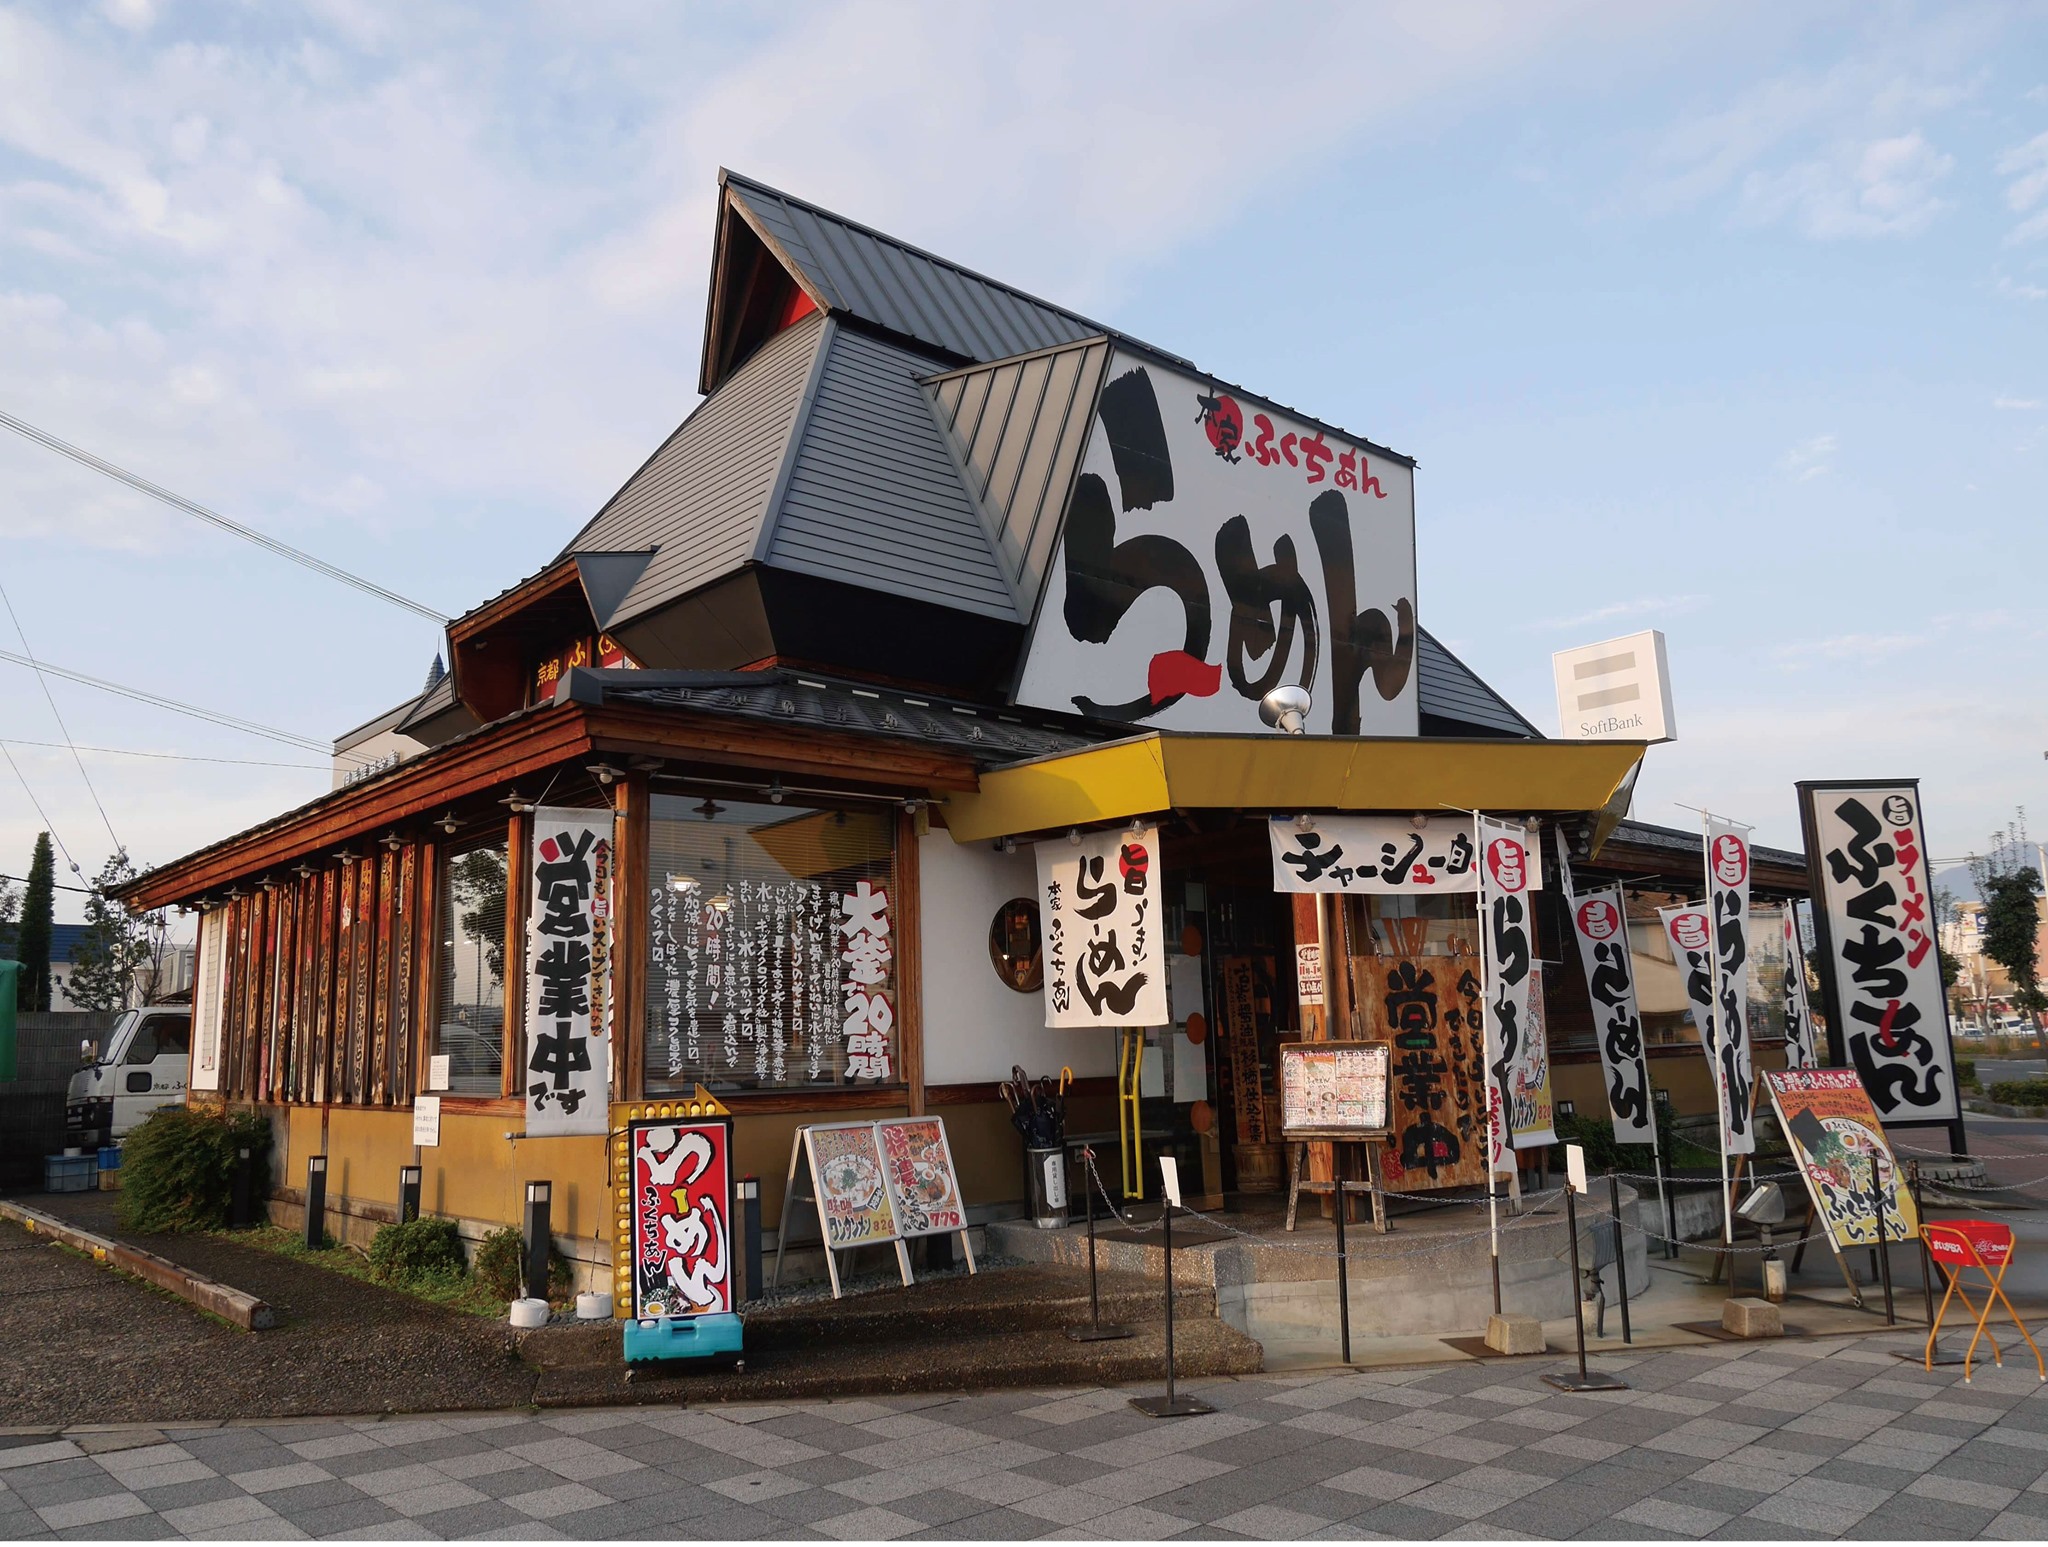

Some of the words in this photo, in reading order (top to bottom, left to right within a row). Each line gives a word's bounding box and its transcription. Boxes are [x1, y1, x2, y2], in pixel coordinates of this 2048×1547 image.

[1194, 387, 1242, 465] 本家
[1244, 413, 1388, 498] ふくちあん
[1063, 366, 1414, 735] らーめん
[537, 658, 560, 687] 京都
[1580, 713, 1643, 737] SoftBank
[529, 828, 596, 1115] 営業中です
[1047, 880, 1063, 912] 本家
[1048, 917, 1071, 1014] ふくちあん
[1073, 855, 1149, 1017] らーめん
[1826, 797, 1945, 1114] ふくちあん
[1893, 828, 1933, 969] ラーメン
[840, 881, 893, 1078] 大釜で20時間
[1492, 894, 1529, 1151] らーめん
[1384, 960, 1461, 1180] 営業中
[637, 1128, 726, 1314] らーめん
[642, 1186, 667, 1276] ふくちあん
[829, 1216, 872, 1241] ワンタンメン
